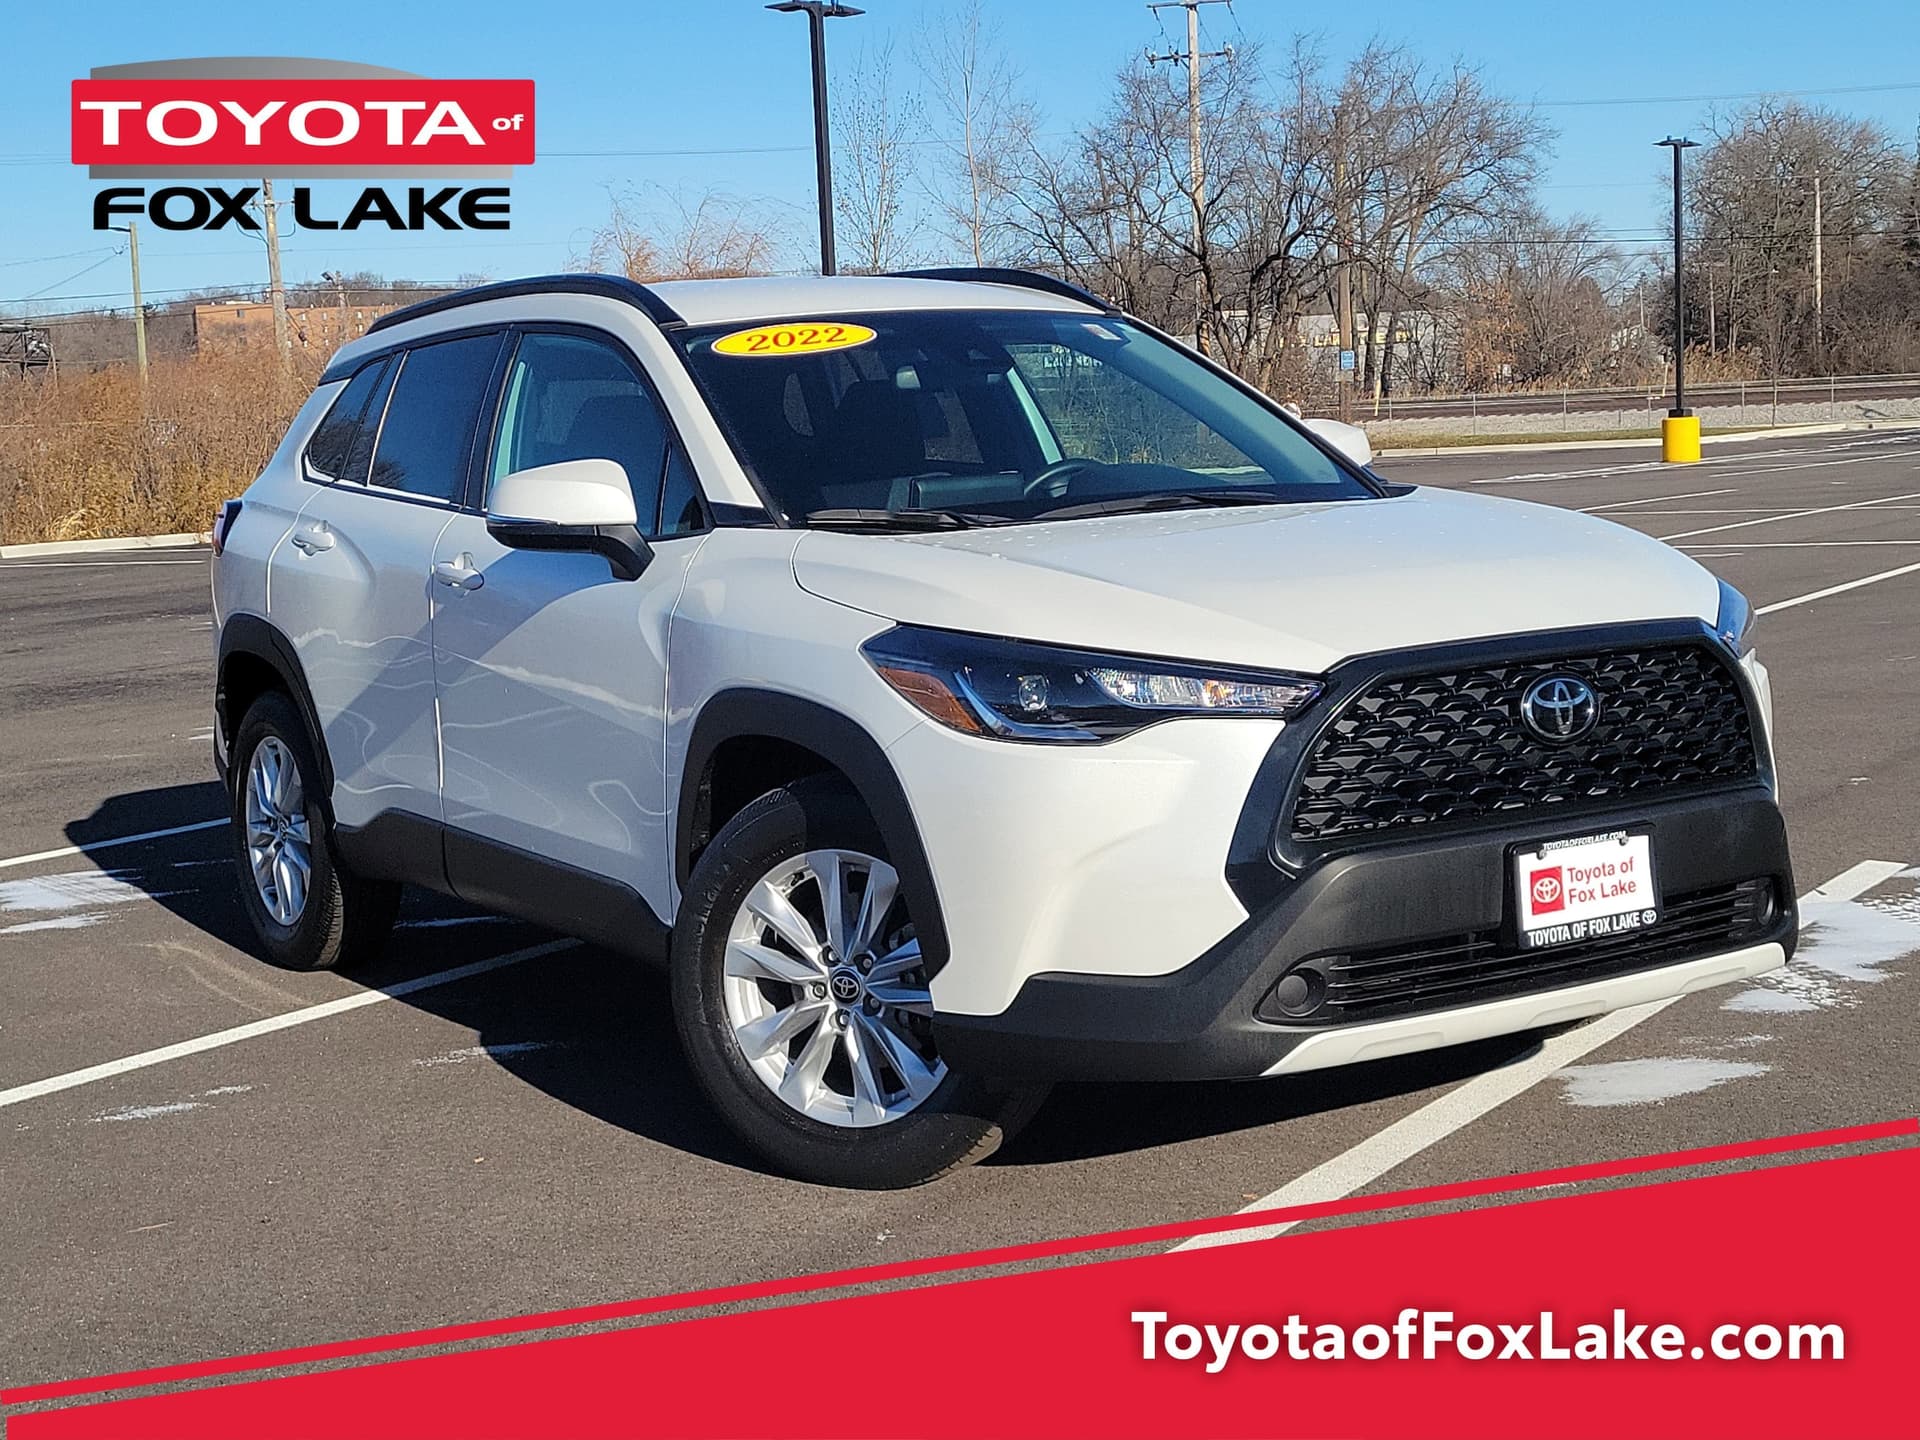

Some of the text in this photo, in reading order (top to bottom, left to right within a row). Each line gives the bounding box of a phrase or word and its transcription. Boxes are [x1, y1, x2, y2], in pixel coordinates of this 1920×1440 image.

[746, 326, 848, 351] 2022
[1567, 855, 1635, 885] Toyota of
[1568, 879, 1638, 905] Fox Lake
[1527, 911, 1641, 947] TOYOTA OF FOX LAKE
